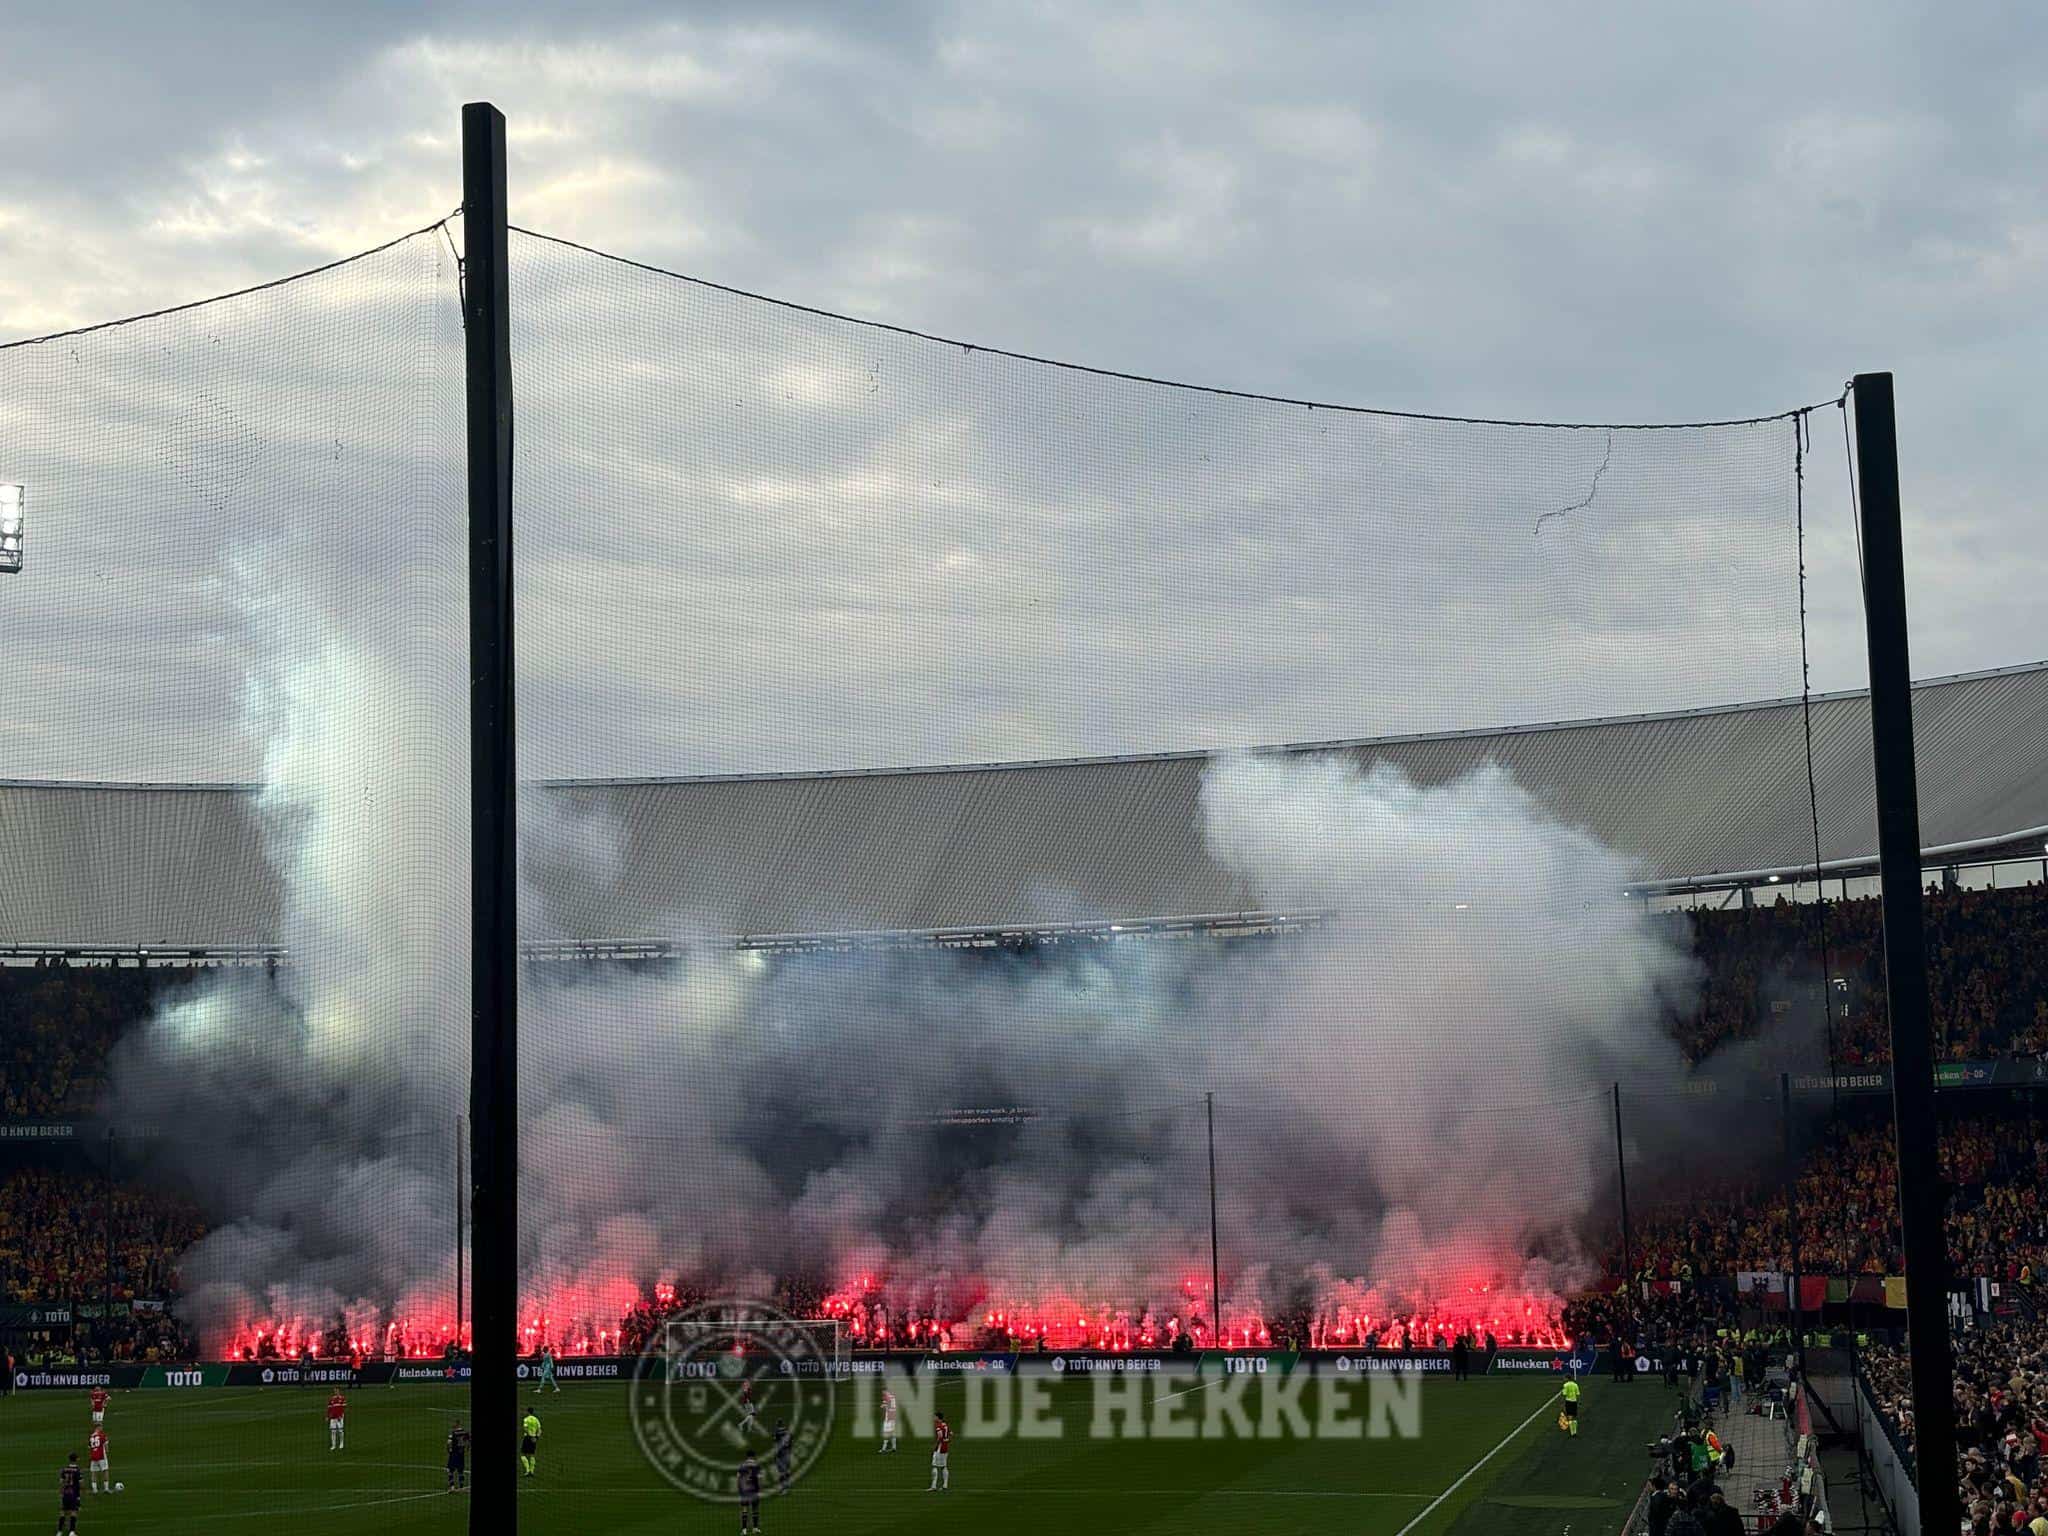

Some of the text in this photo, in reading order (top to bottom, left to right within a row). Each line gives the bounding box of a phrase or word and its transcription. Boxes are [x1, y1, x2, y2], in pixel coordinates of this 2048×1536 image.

[1850, 1075, 1883, 1088] BEKER
[45, 1310, 70, 1322] TOTO
[678, 1361, 716, 1377] TOTO
[794, 1359, 819, 1372] TOTO
[851, 1359, 885, 1371] BEKER
[927, 1360, 975, 1370] Heineken
[1068, 1357, 1161, 1370] TOTO KNVB BEKER
[1224, 1357, 1268, 1373] TOTO
[1353, 1357, 1451, 1371] TOTO KNVB BEKER
[1497, 1359, 1550, 1369] Heineken
[277, 1368, 300, 1381] TOTO
[399, 1367, 444, 1378] Heineken
[556, 1365, 584, 1377] KNVB
[586, 1365, 618, 1376] BEKER
[30, 1373, 111, 1386] TOTO KNVB BEKER
[165, 1371, 202, 1386] TOTO
